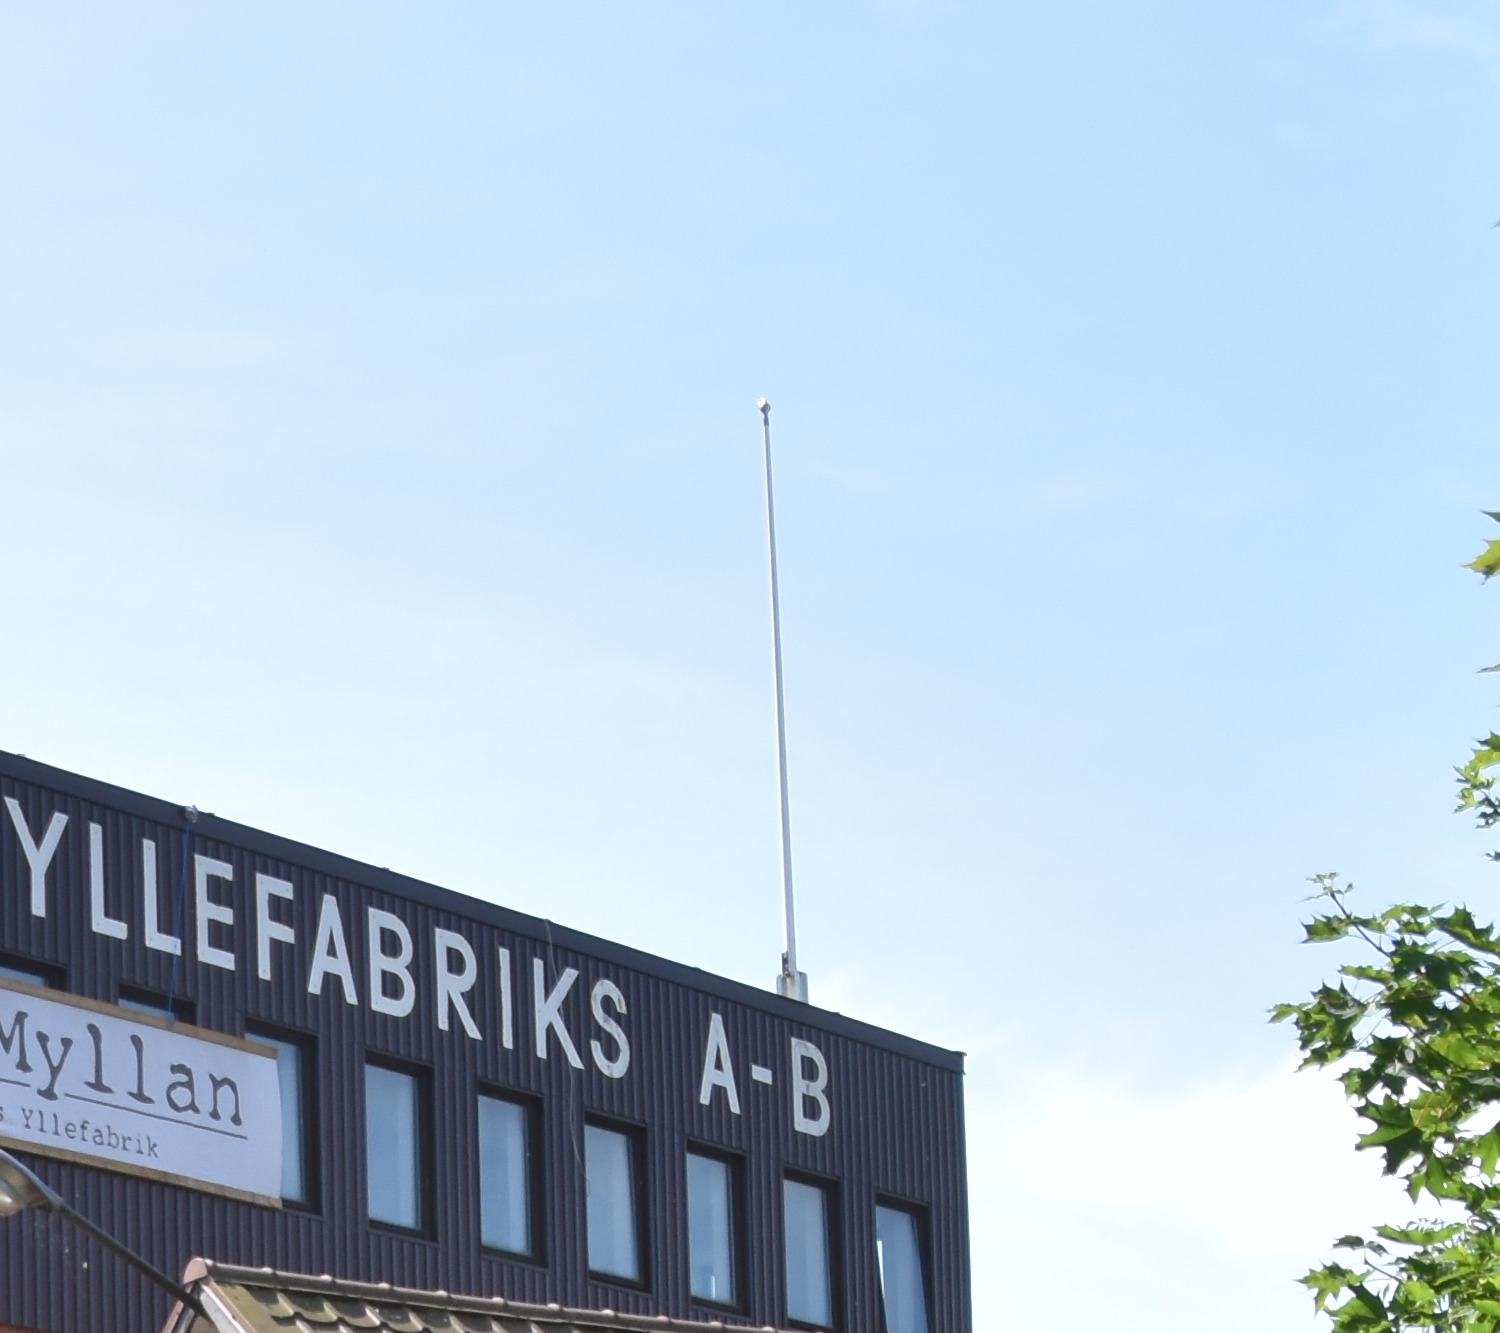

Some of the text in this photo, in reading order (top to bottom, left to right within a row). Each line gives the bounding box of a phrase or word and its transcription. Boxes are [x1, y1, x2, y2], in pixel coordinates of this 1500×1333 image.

[3, 795, 632, 1080] YLLEFABRIKS
[699, 1012, 832, 1138] A-B
[21, 1107, 159, 1159] Yllefabrik
